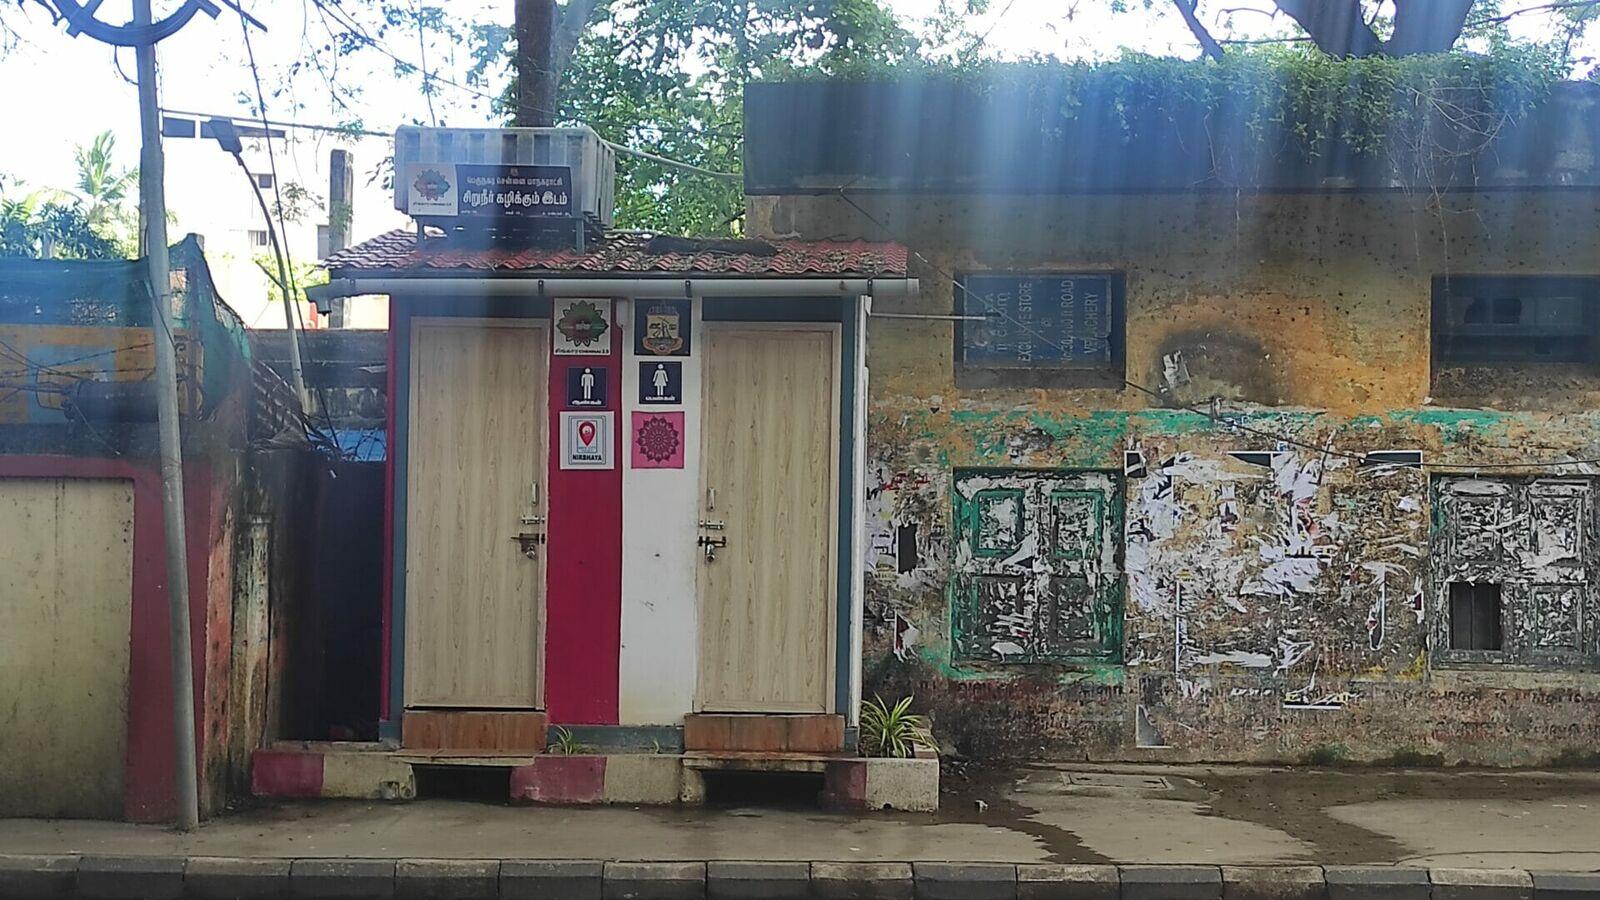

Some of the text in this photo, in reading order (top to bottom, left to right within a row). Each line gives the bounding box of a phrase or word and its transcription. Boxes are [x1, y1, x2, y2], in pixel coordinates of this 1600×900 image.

[463, 188, 568, 208] சிறுநீர் கழிக்கும் இடம்
[1017, 282, 1032, 313] STORE
[1061, 280, 1075, 308] ROAD
[572, 453, 602, 461] NIRBHAYA
